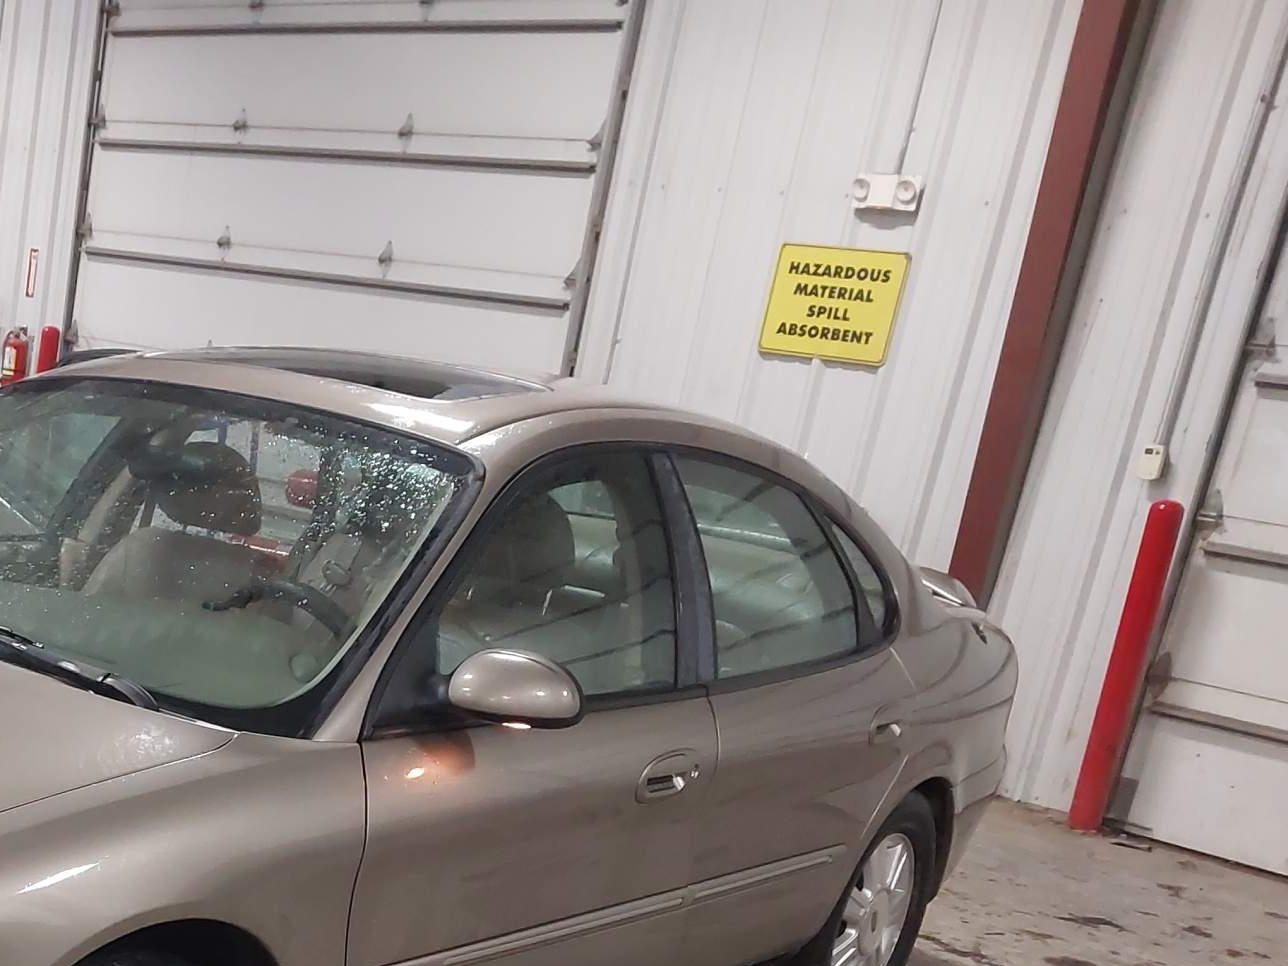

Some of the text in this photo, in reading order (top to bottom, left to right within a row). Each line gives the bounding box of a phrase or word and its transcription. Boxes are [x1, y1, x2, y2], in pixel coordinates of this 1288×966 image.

[788, 261, 892, 283] HAZARDOUS
[793, 283, 874, 303] MATERIAL
[806, 304, 850, 322] SPILL
[776, 322, 873, 345] ABSORBENT
